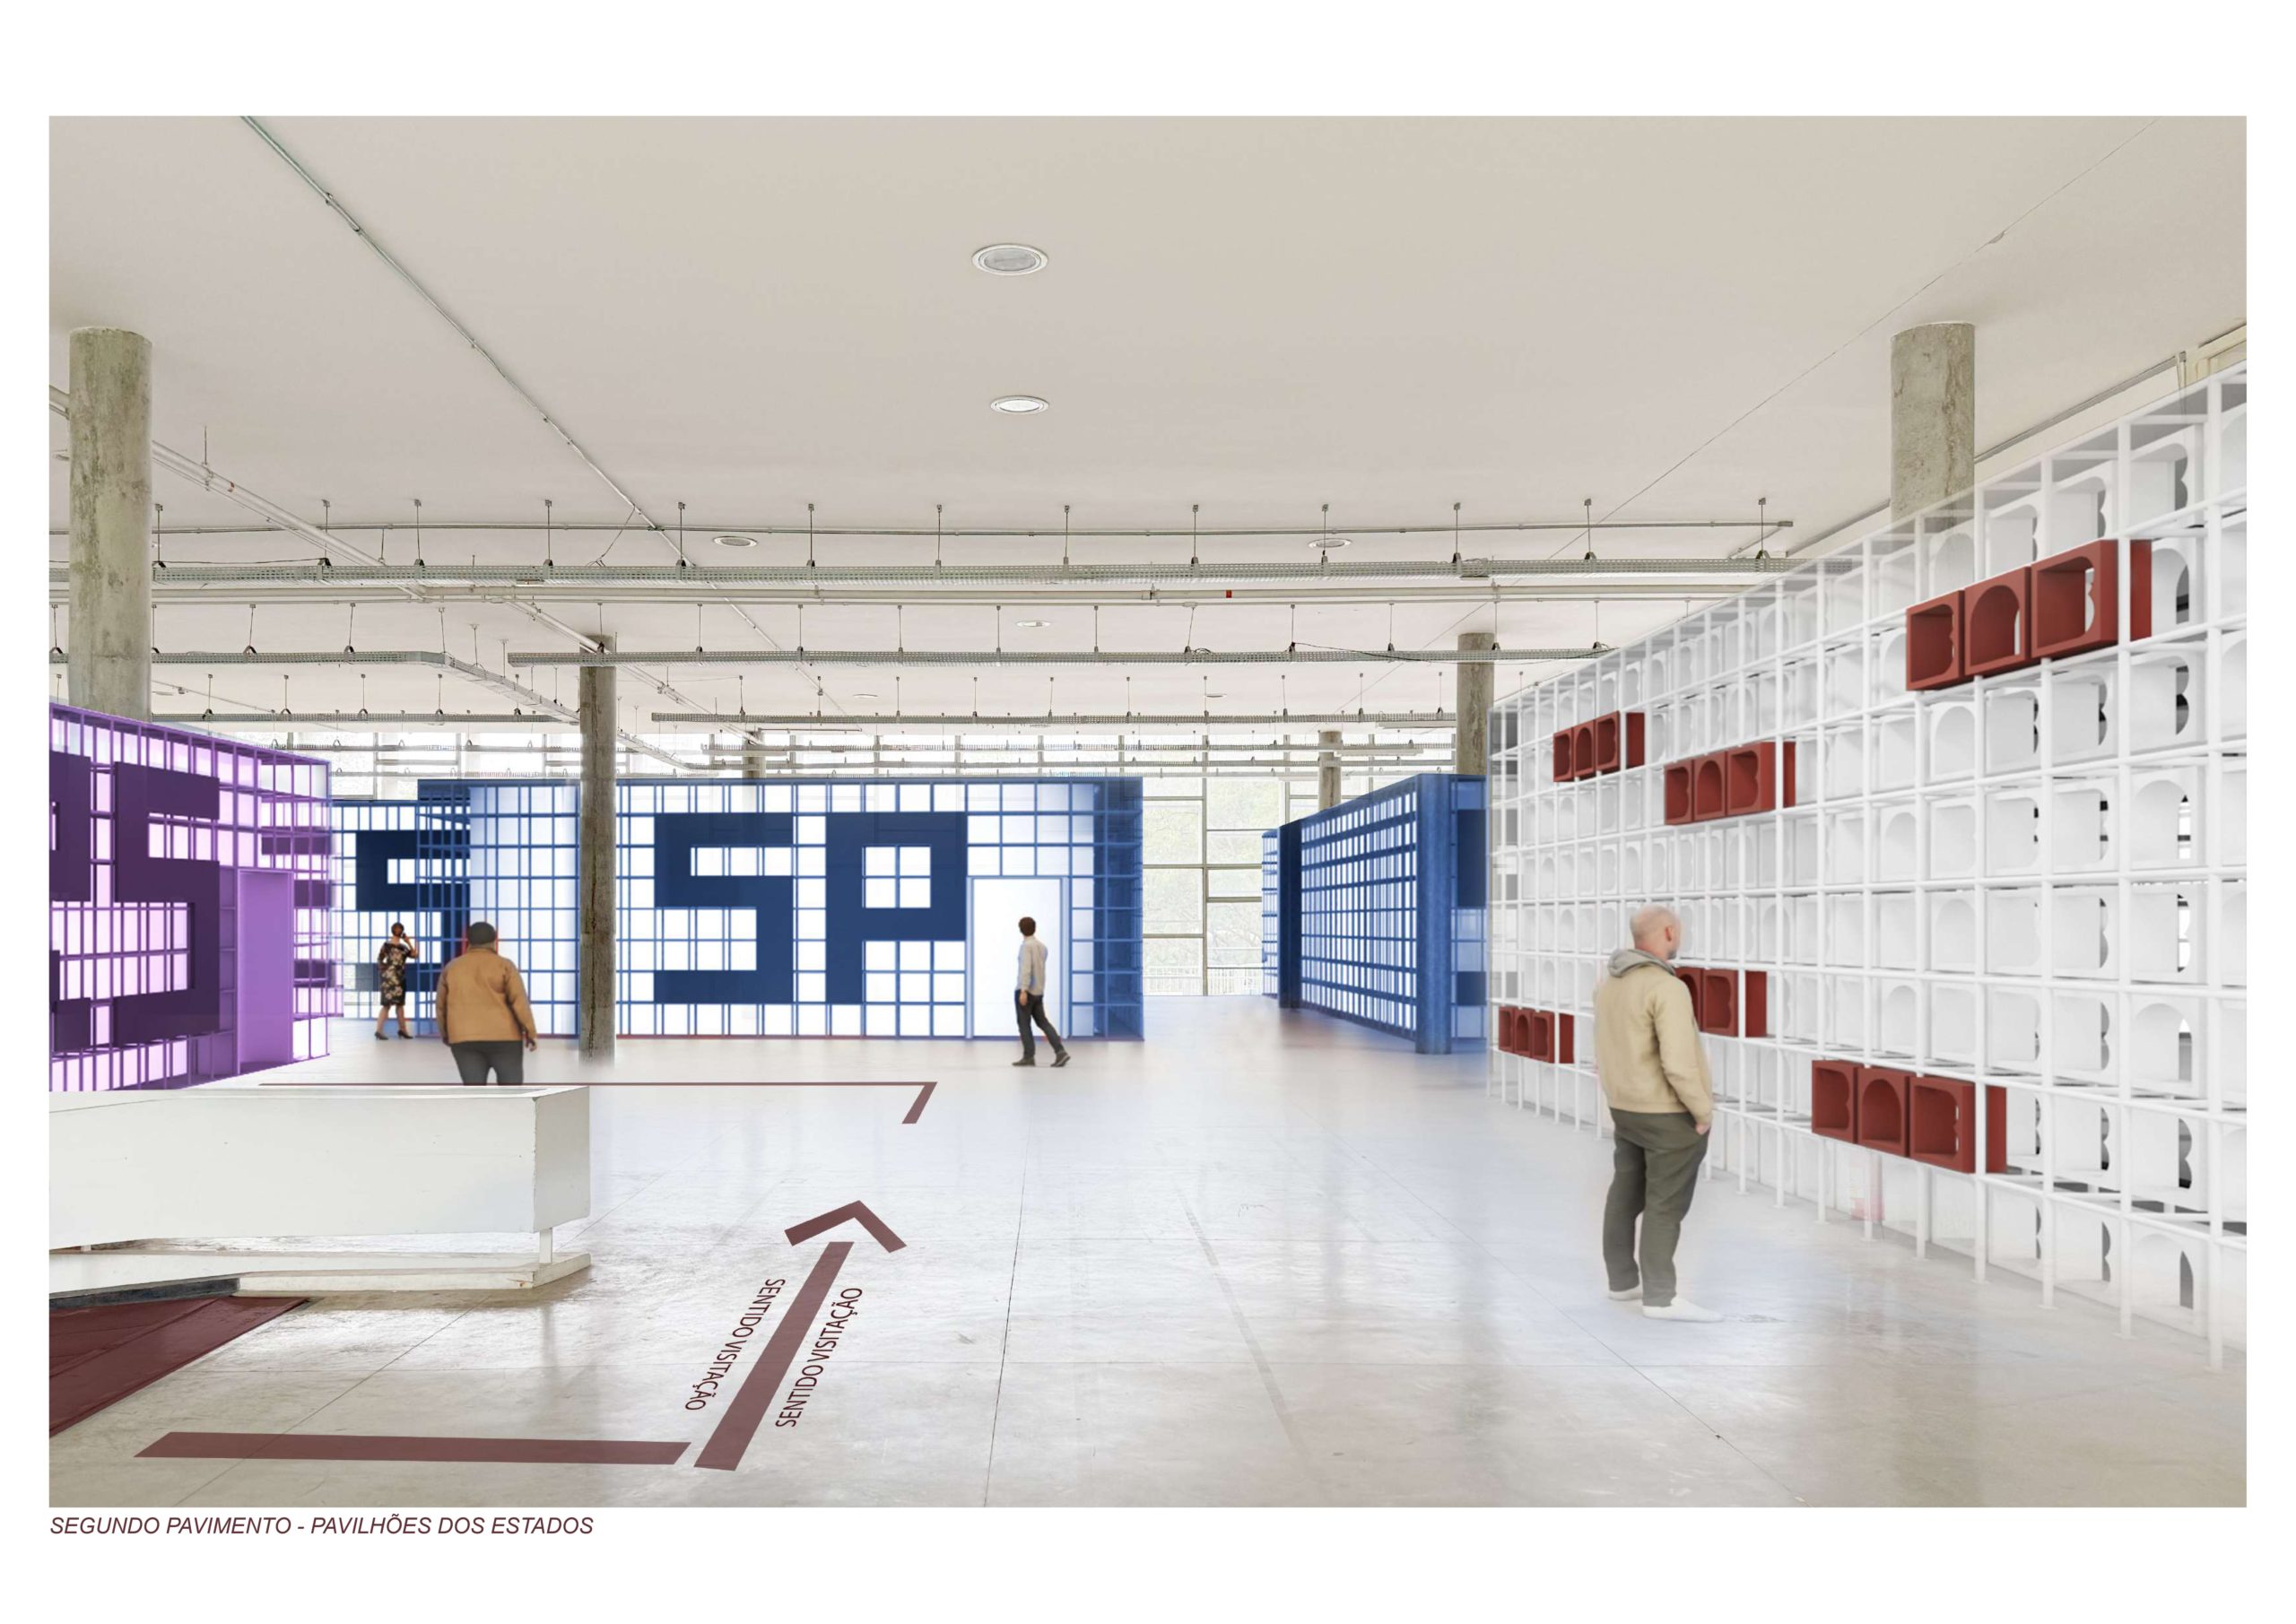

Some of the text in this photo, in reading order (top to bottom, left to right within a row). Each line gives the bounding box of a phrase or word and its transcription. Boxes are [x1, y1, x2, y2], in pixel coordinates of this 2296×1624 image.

[654, 812, 966, 1003] SP
[685, 1278, 786, 1411] SENTIDO VISITAÇÃO
[775, 1288, 863, 1428] SENTIDO VISITAÇÃO
